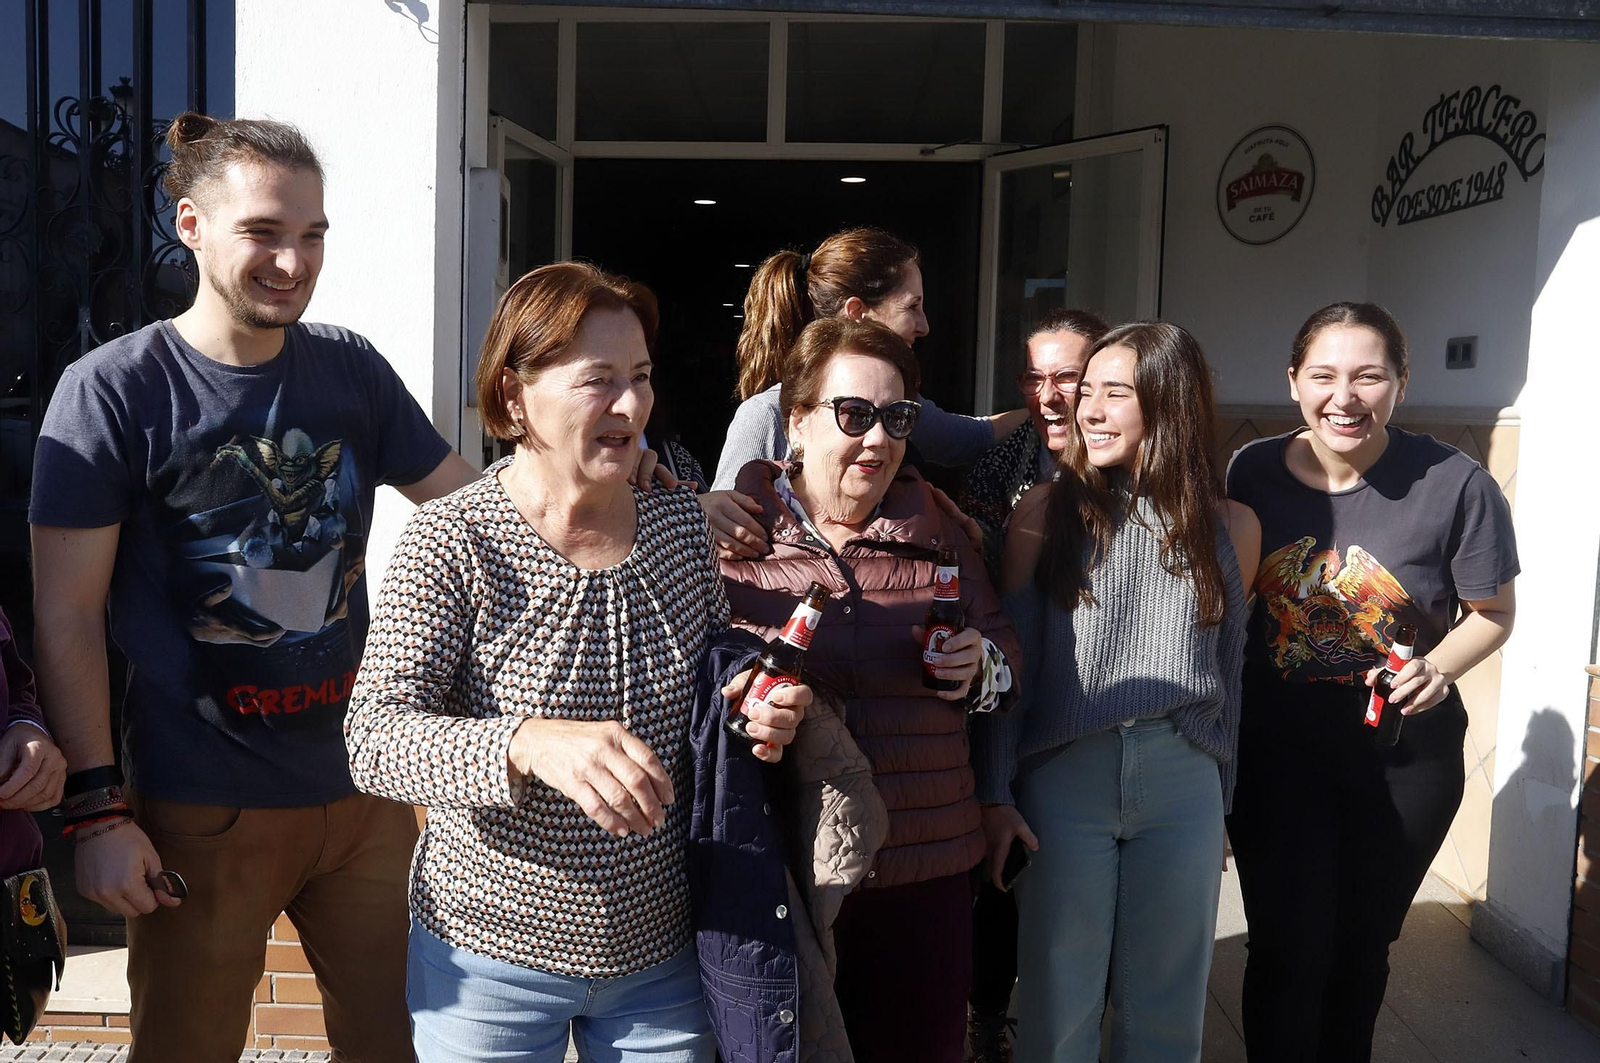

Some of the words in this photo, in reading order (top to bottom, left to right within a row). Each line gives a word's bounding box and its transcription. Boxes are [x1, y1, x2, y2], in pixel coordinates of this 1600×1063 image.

[1371, 131, 1421, 228] BAR
[1422, 84, 1547, 178] TERCERO
[1230, 172, 1298, 199] SAIMAZA
[1396, 178, 1464, 221] DESDE
[1465, 161, 1508, 207] 1948
[1248, 211, 1275, 223] CAFÉ
